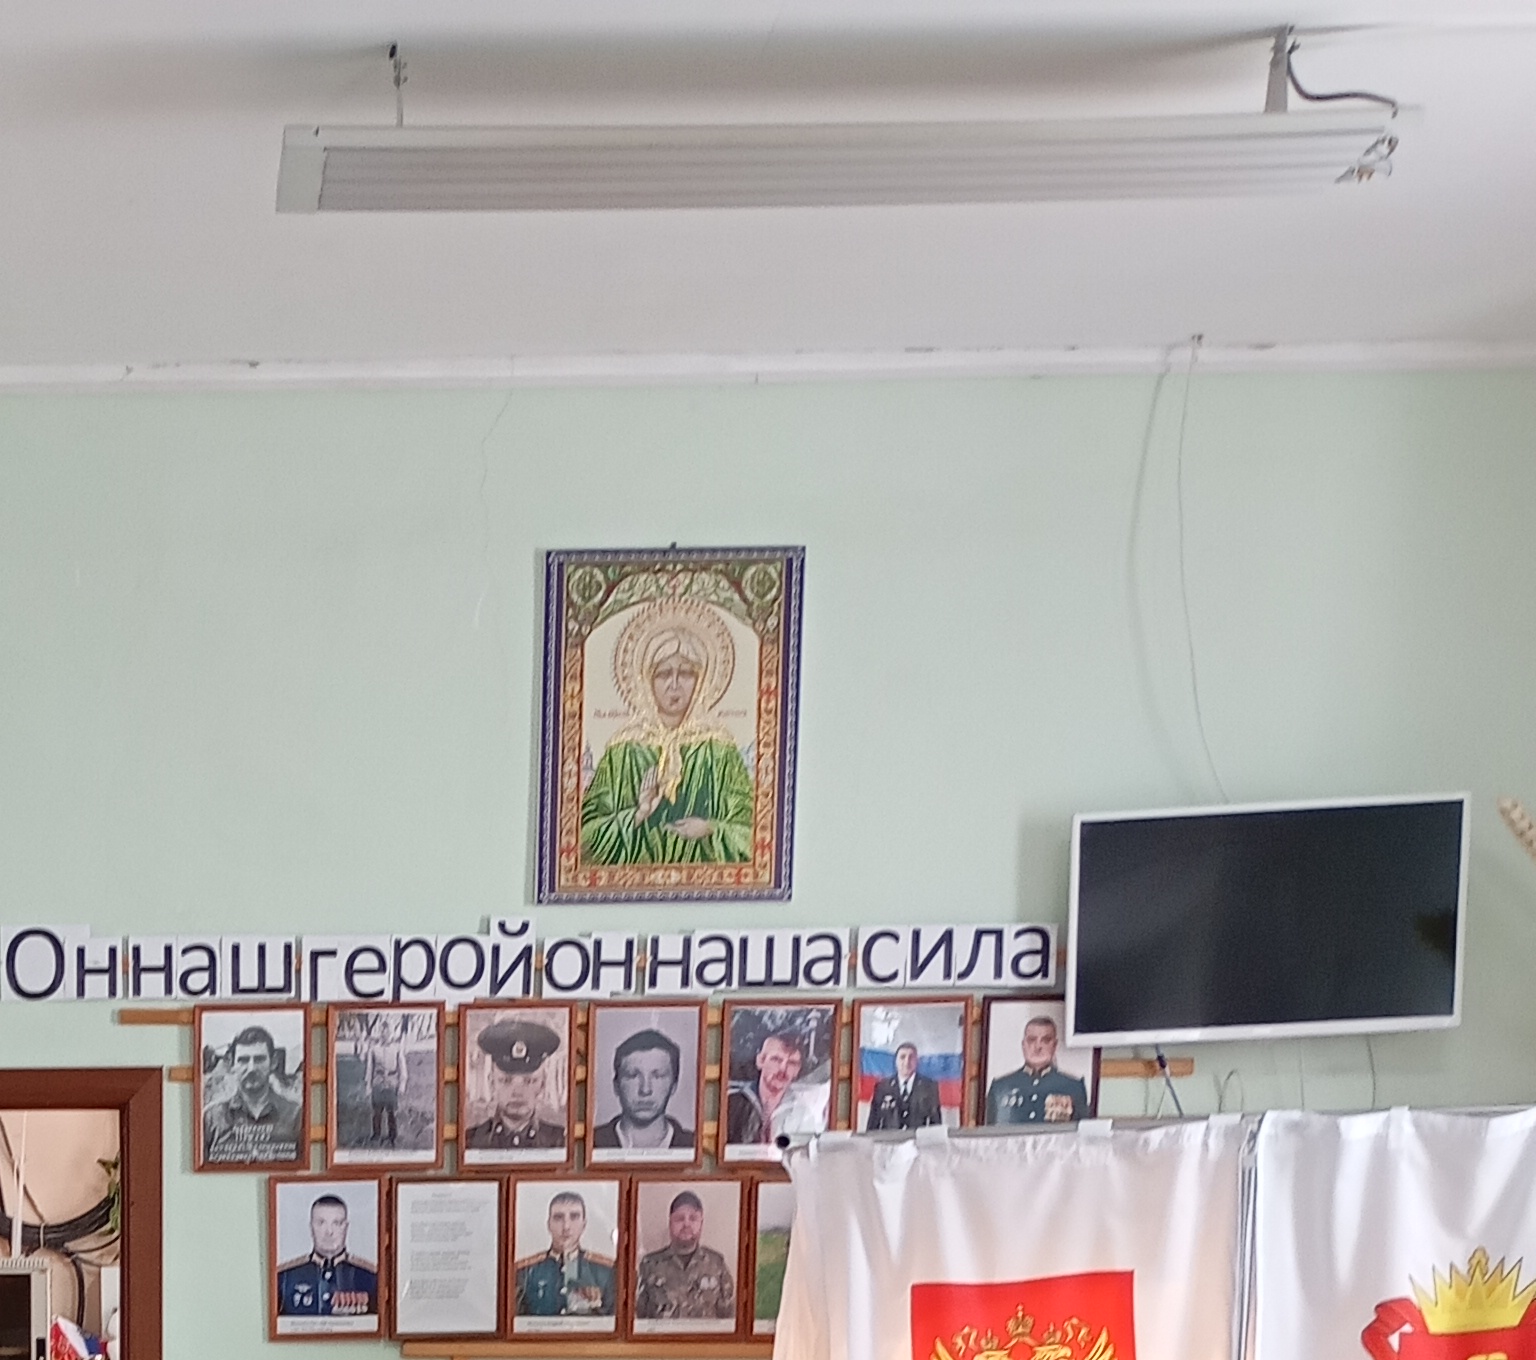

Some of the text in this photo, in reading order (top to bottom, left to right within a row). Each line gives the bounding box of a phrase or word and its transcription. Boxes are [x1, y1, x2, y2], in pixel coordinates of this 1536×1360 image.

[5, 919, 1051, 1003] Он наш герой он наша сила
